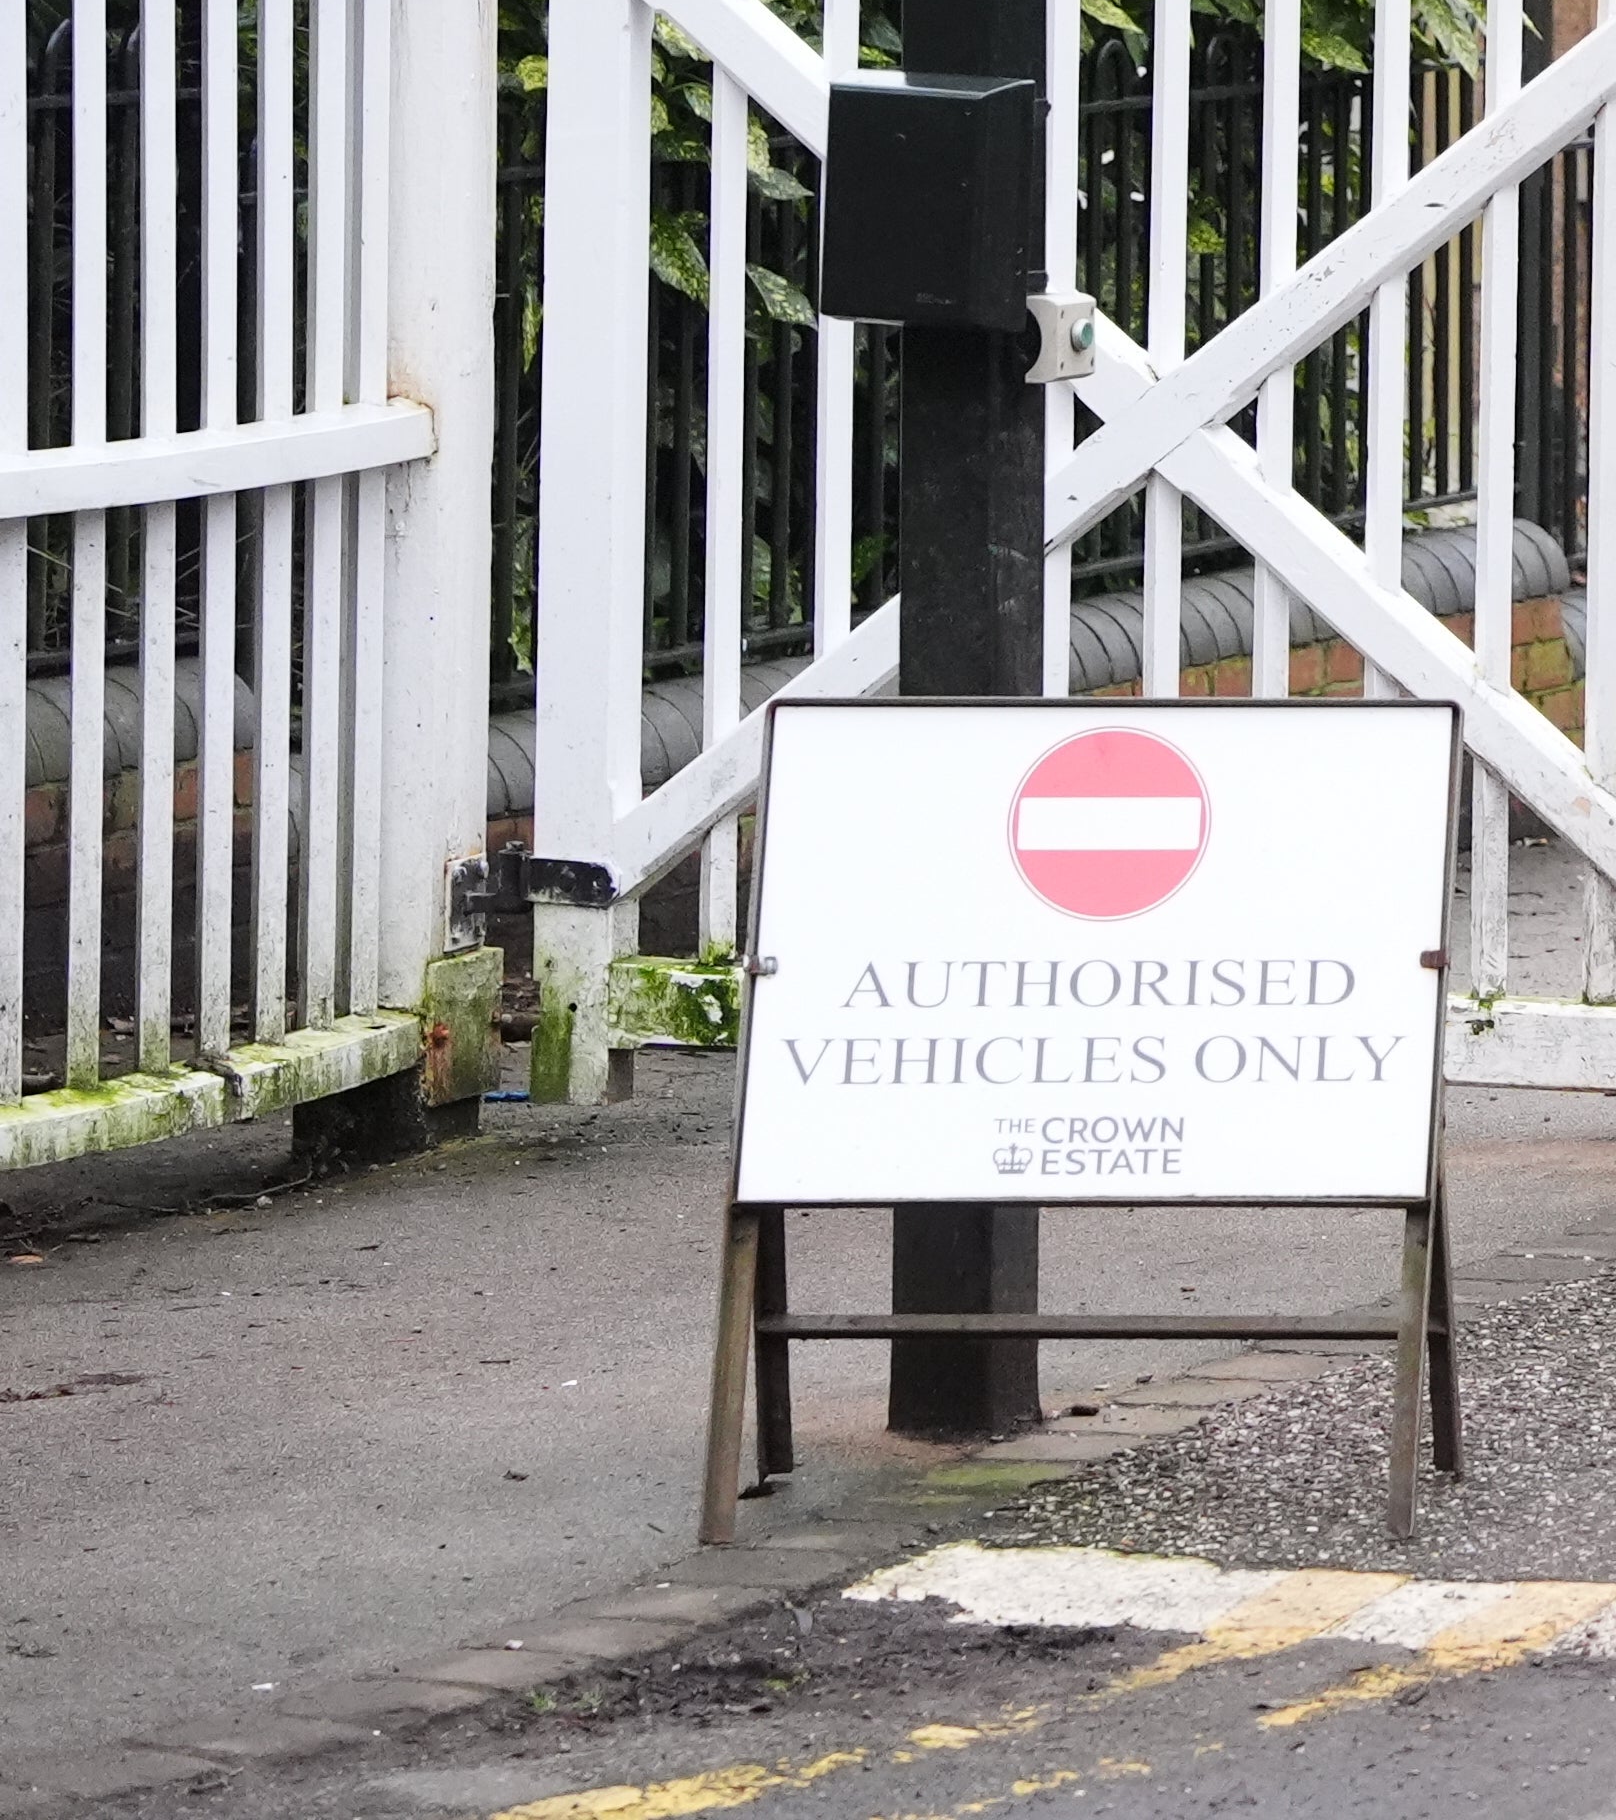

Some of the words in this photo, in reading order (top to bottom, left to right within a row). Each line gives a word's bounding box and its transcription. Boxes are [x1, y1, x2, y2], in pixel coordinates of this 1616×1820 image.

[840, 959, 1356, 1008] AUTHORISED
[783, 1036, 1168, 1085] VEHICLES
[1194, 1035, 1406, 1083] ONLY
[994, 1118, 1036, 1134] THE
[1041, 1116, 1185, 1144] CROWN
[1040, 1148, 1182, 1176] ESTATE
